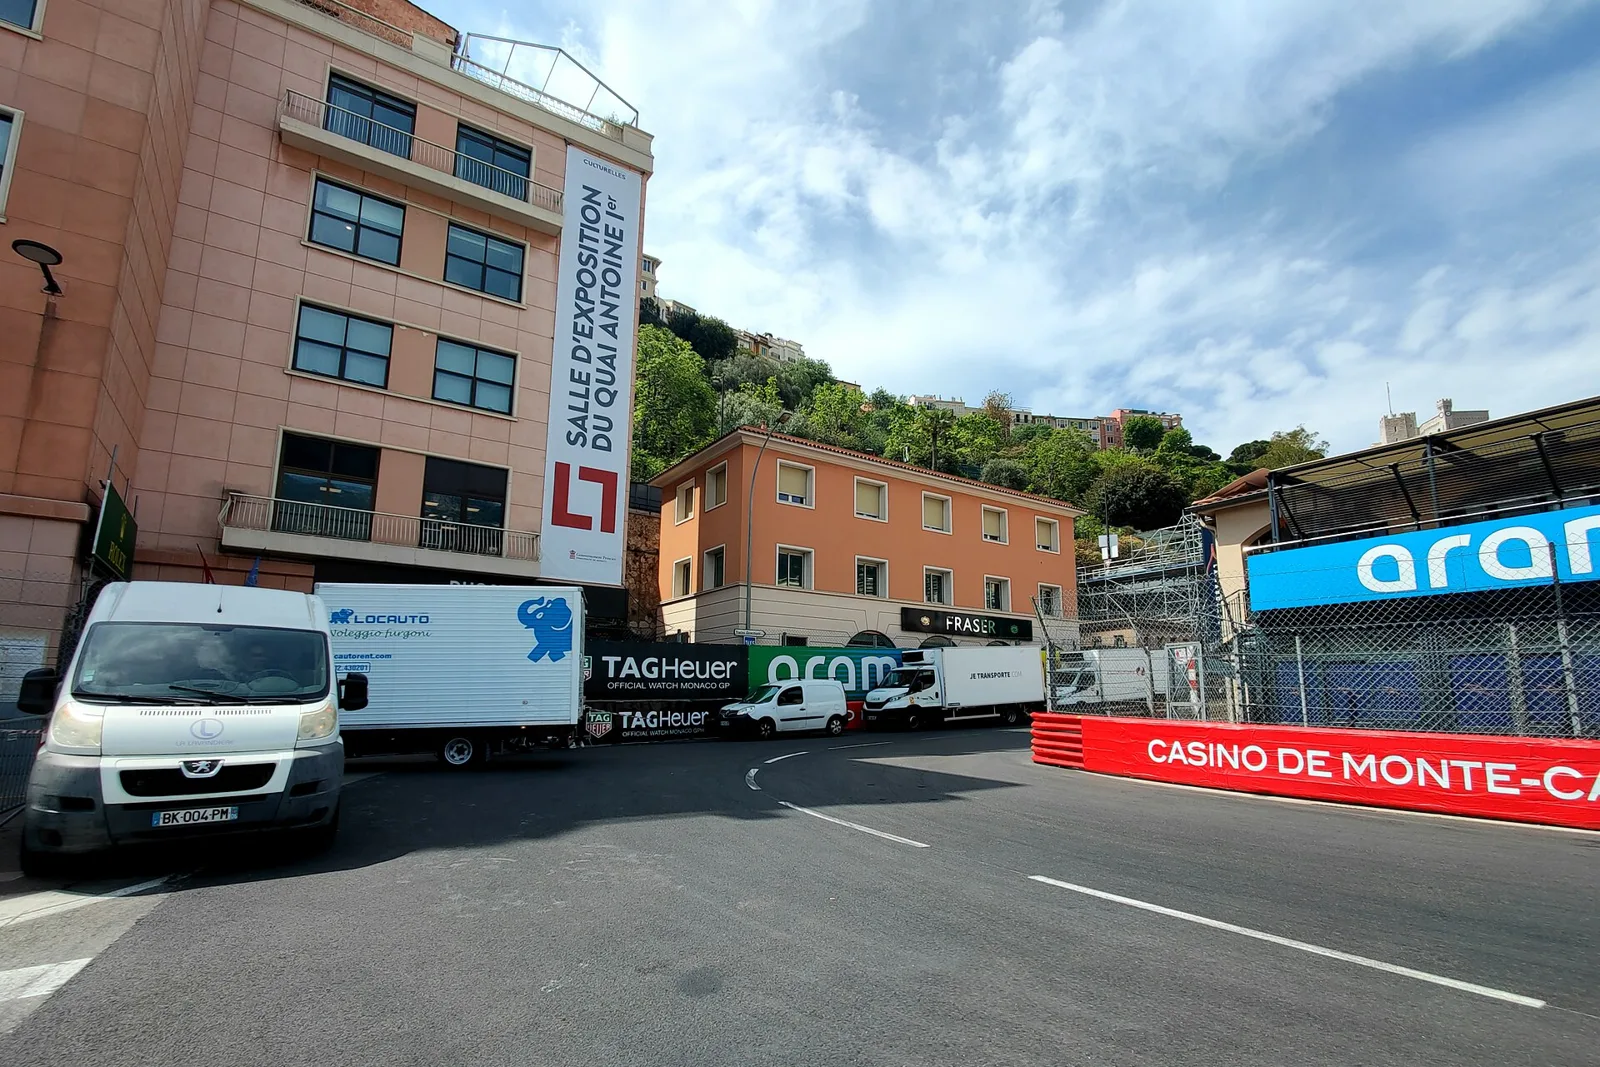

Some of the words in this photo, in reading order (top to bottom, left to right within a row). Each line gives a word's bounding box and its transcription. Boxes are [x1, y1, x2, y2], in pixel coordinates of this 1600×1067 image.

[583, 158, 627, 180] CULTURELLES
[571, 184, 602, 365] D'EXPOSITION
[598, 223, 625, 341] ANTOINE
[594, 343, 619, 408] QUAI
[566, 368, 591, 448] SALLE
[592, 414, 614, 452] DU
[354, 615, 430, 624] LOCAUTO
[946, 616, 996, 634] FRASER
[385, 628, 432, 639] furgoni
[607, 682, 646, 690] OFFICIAL
[649, 682, 679, 690] WATCH
[589, 714, 610, 722] TAG
[650, 728, 669, 736] WATCH
[1147, 739, 1268, 772] CASINO
[1277, 747, 1333, 778] DE
[162, 808, 229, 824] BK-004-PM
